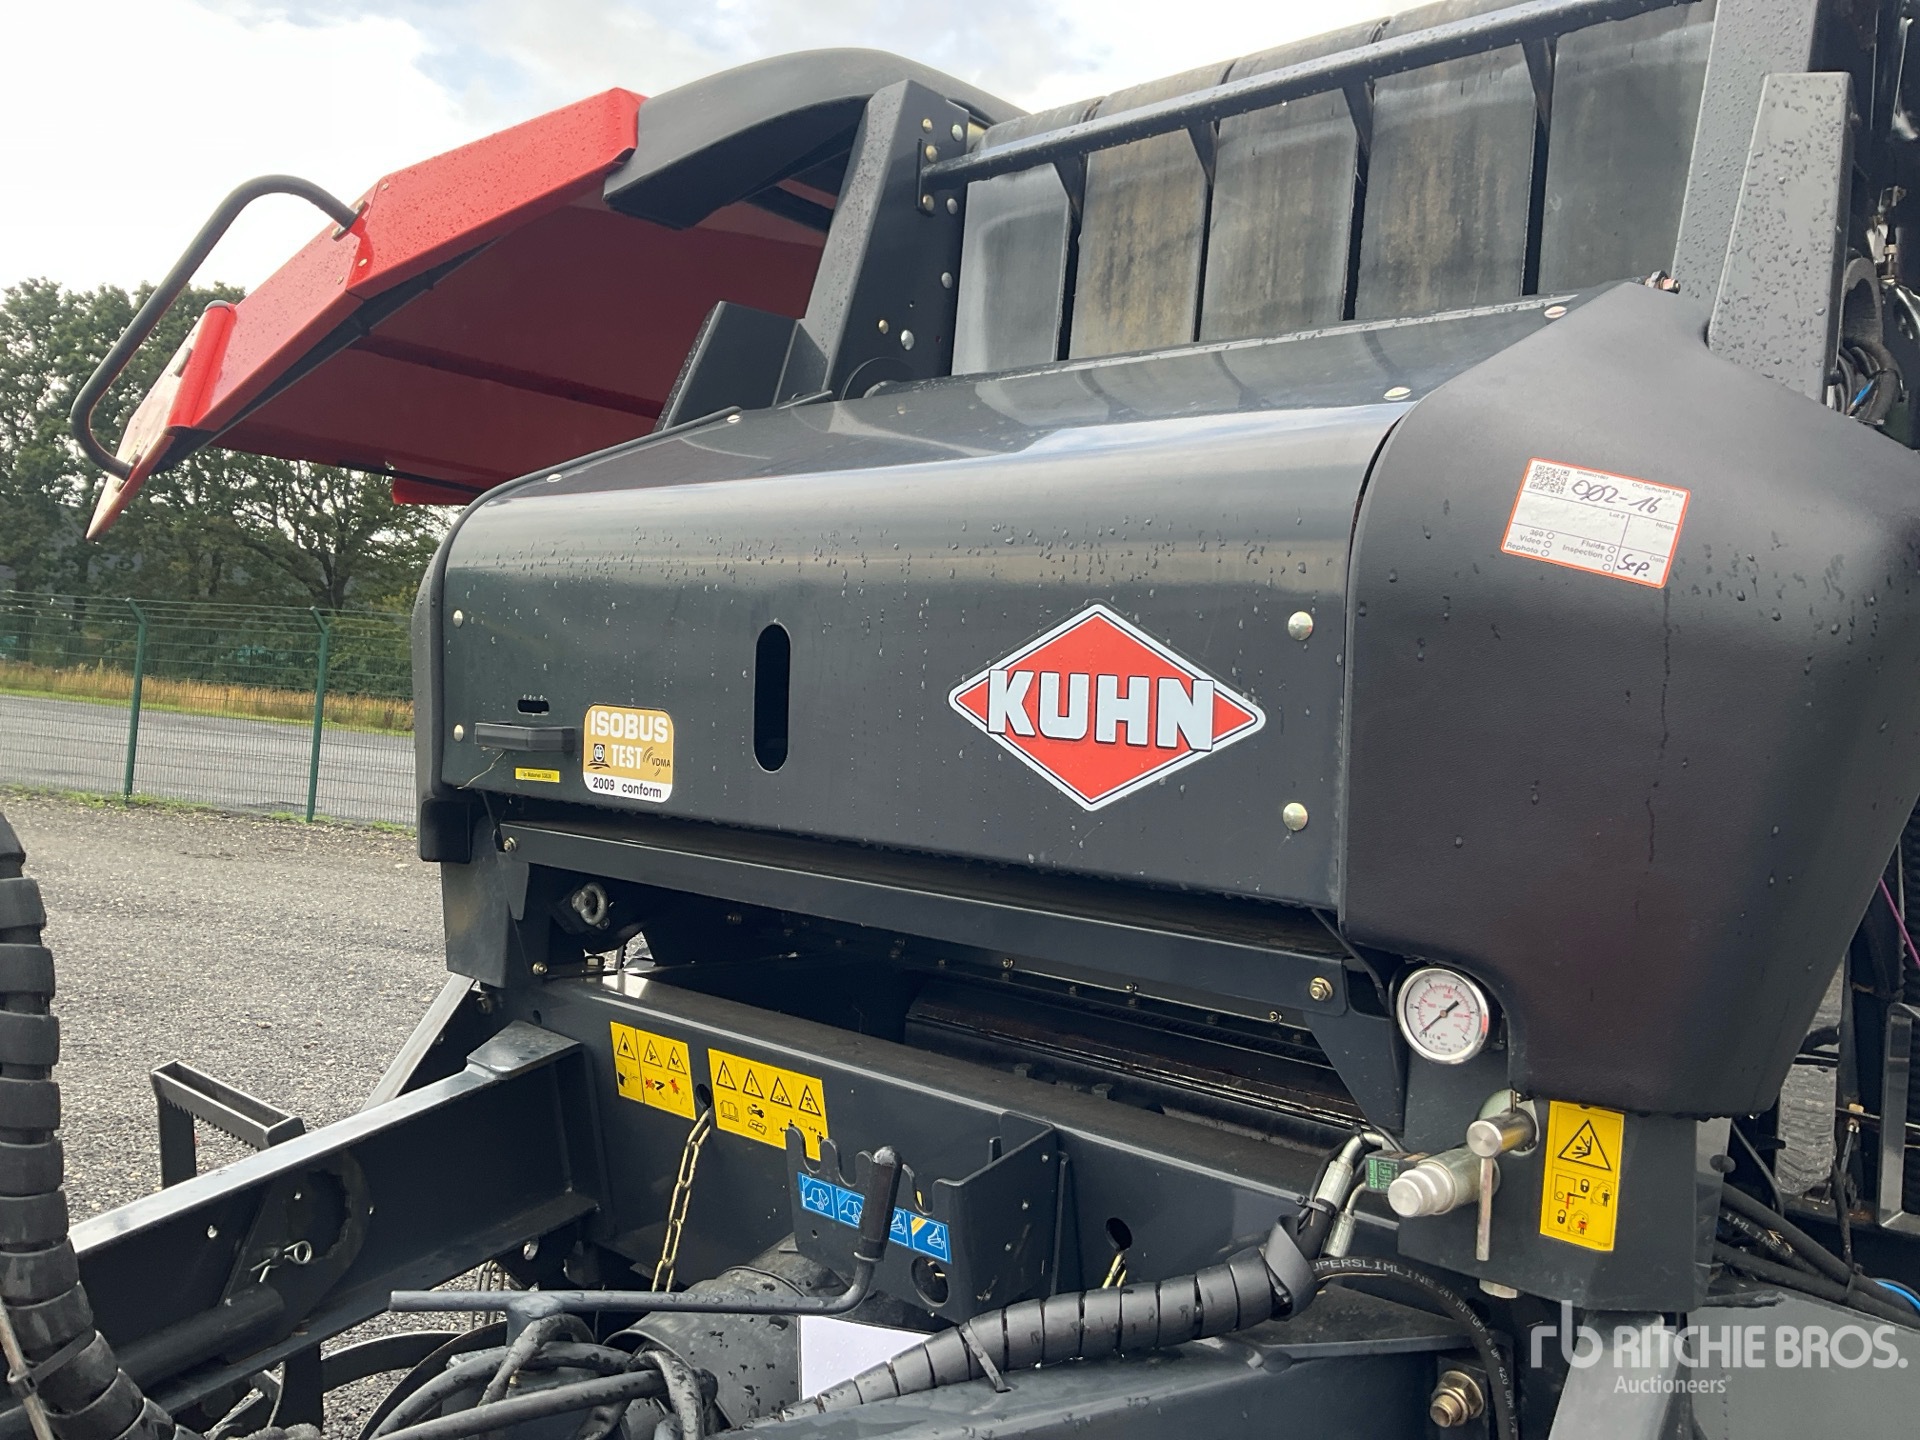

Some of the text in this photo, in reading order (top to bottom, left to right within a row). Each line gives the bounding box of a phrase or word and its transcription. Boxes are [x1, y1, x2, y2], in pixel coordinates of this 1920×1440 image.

[1529, 529, 1545, 538] 360
[1655, 521, 1675, 532] Notes
[1519, 534, 1542, 546] Video
[1581, 539, 1606, 551] Fluids
[1506, 541, 1539, 555] Rephoto
[1562, 544, 1603, 560] Inspection
[987, 669, 1214, 752] KUHN
[590, 710, 668, 743] ISOBUS
[611, 744, 643, 770] TEST
[651, 757, 671, 768] VDMA
[592, 777, 662, 799] 2009 conform
